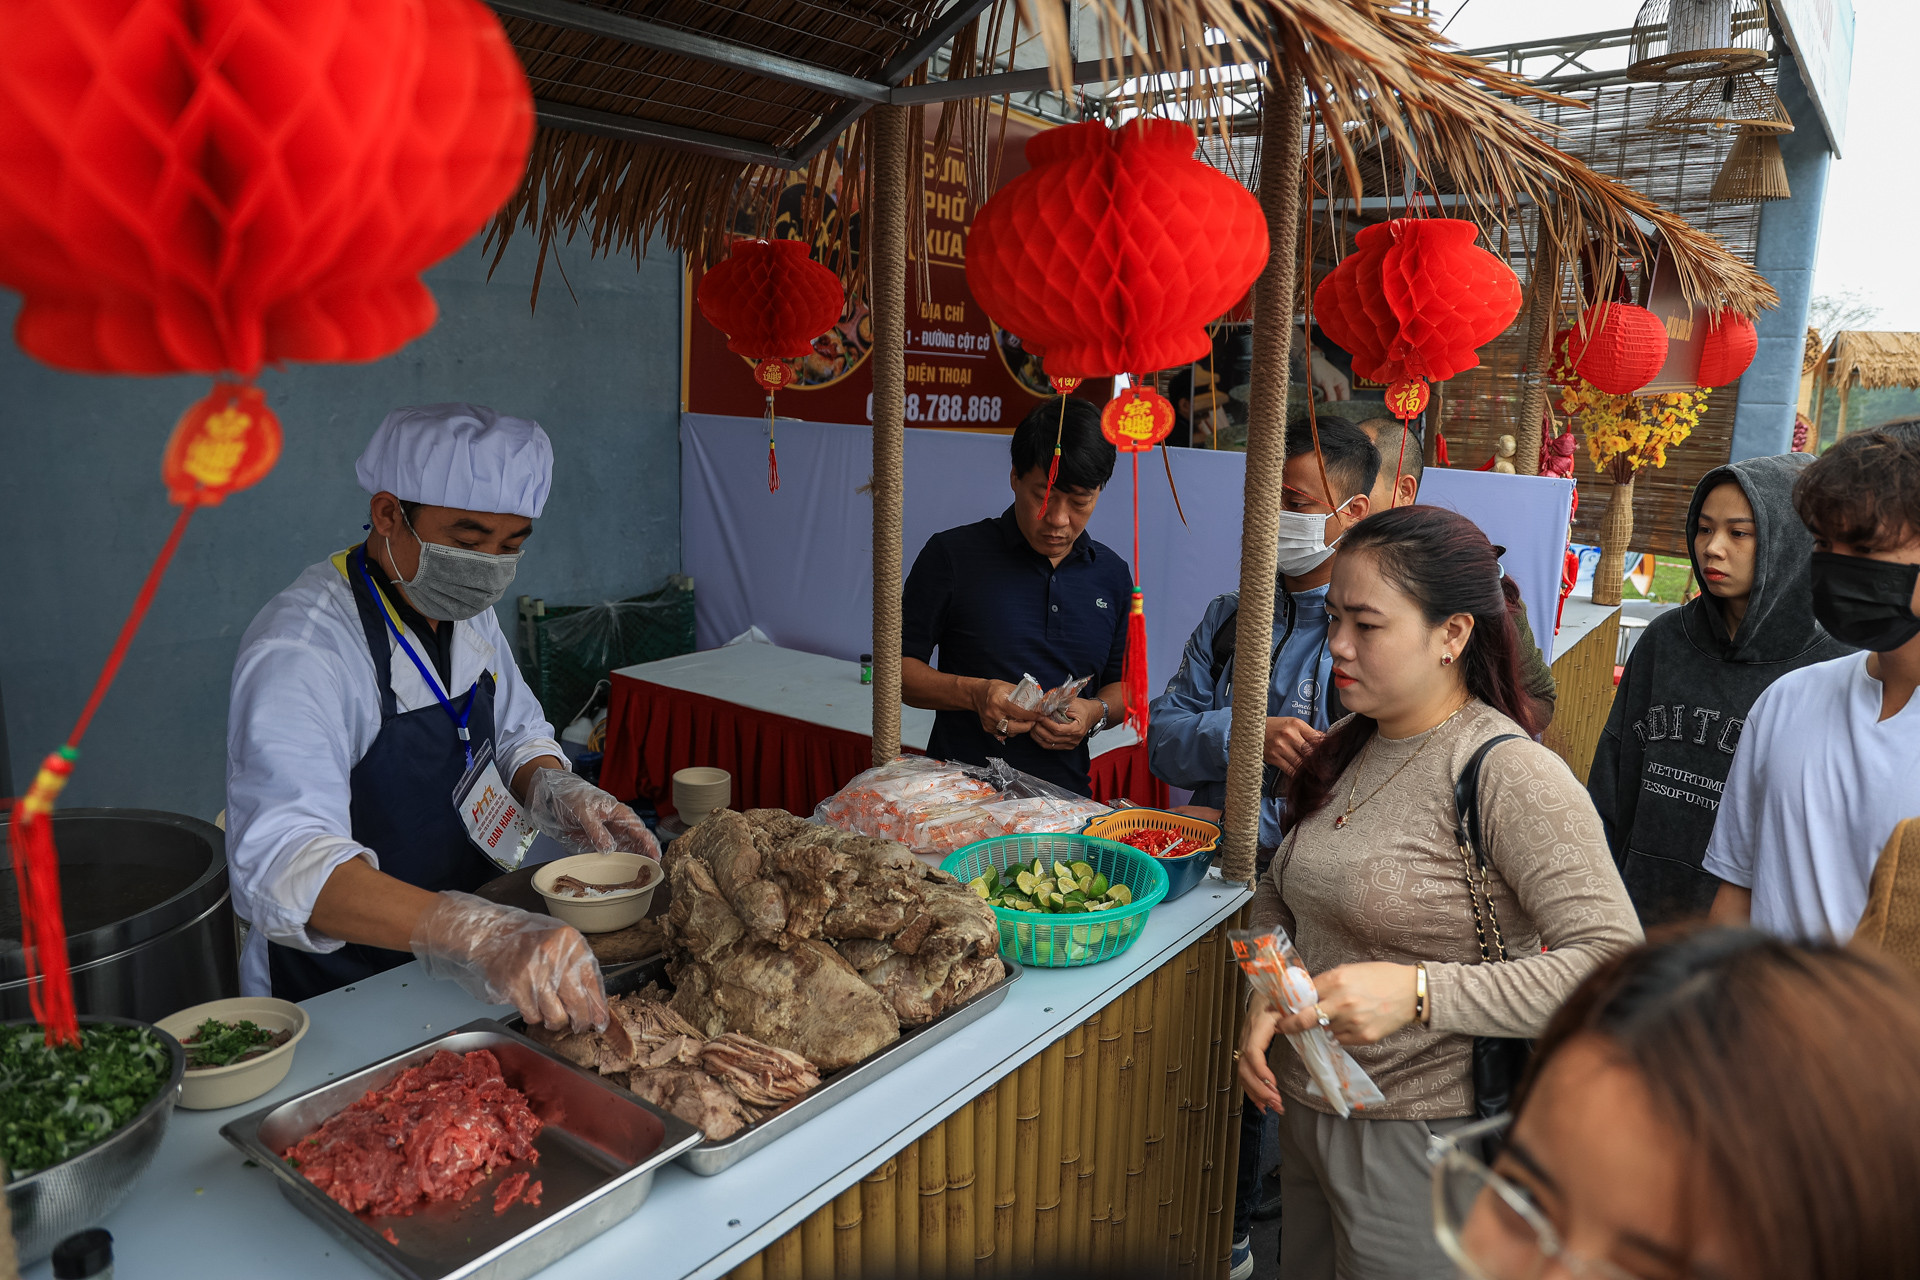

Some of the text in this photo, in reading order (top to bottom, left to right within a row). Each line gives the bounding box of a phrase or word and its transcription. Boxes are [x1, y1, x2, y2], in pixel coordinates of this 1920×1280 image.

[921, 301, 965, 323] ĐỊA CHỈ
[921, 328, 955, 348] ĐƯỜNG
[957, 331, 975, 353] CỘT
[977, 333, 991, 351] CỜ
[906, 362, 972, 388] ĐIỆN THOẠI
[1394, 383, 1421, 412] 福
[487, 827, 504, 849] GIAN
[499, 805, 517, 831] HÀNG
